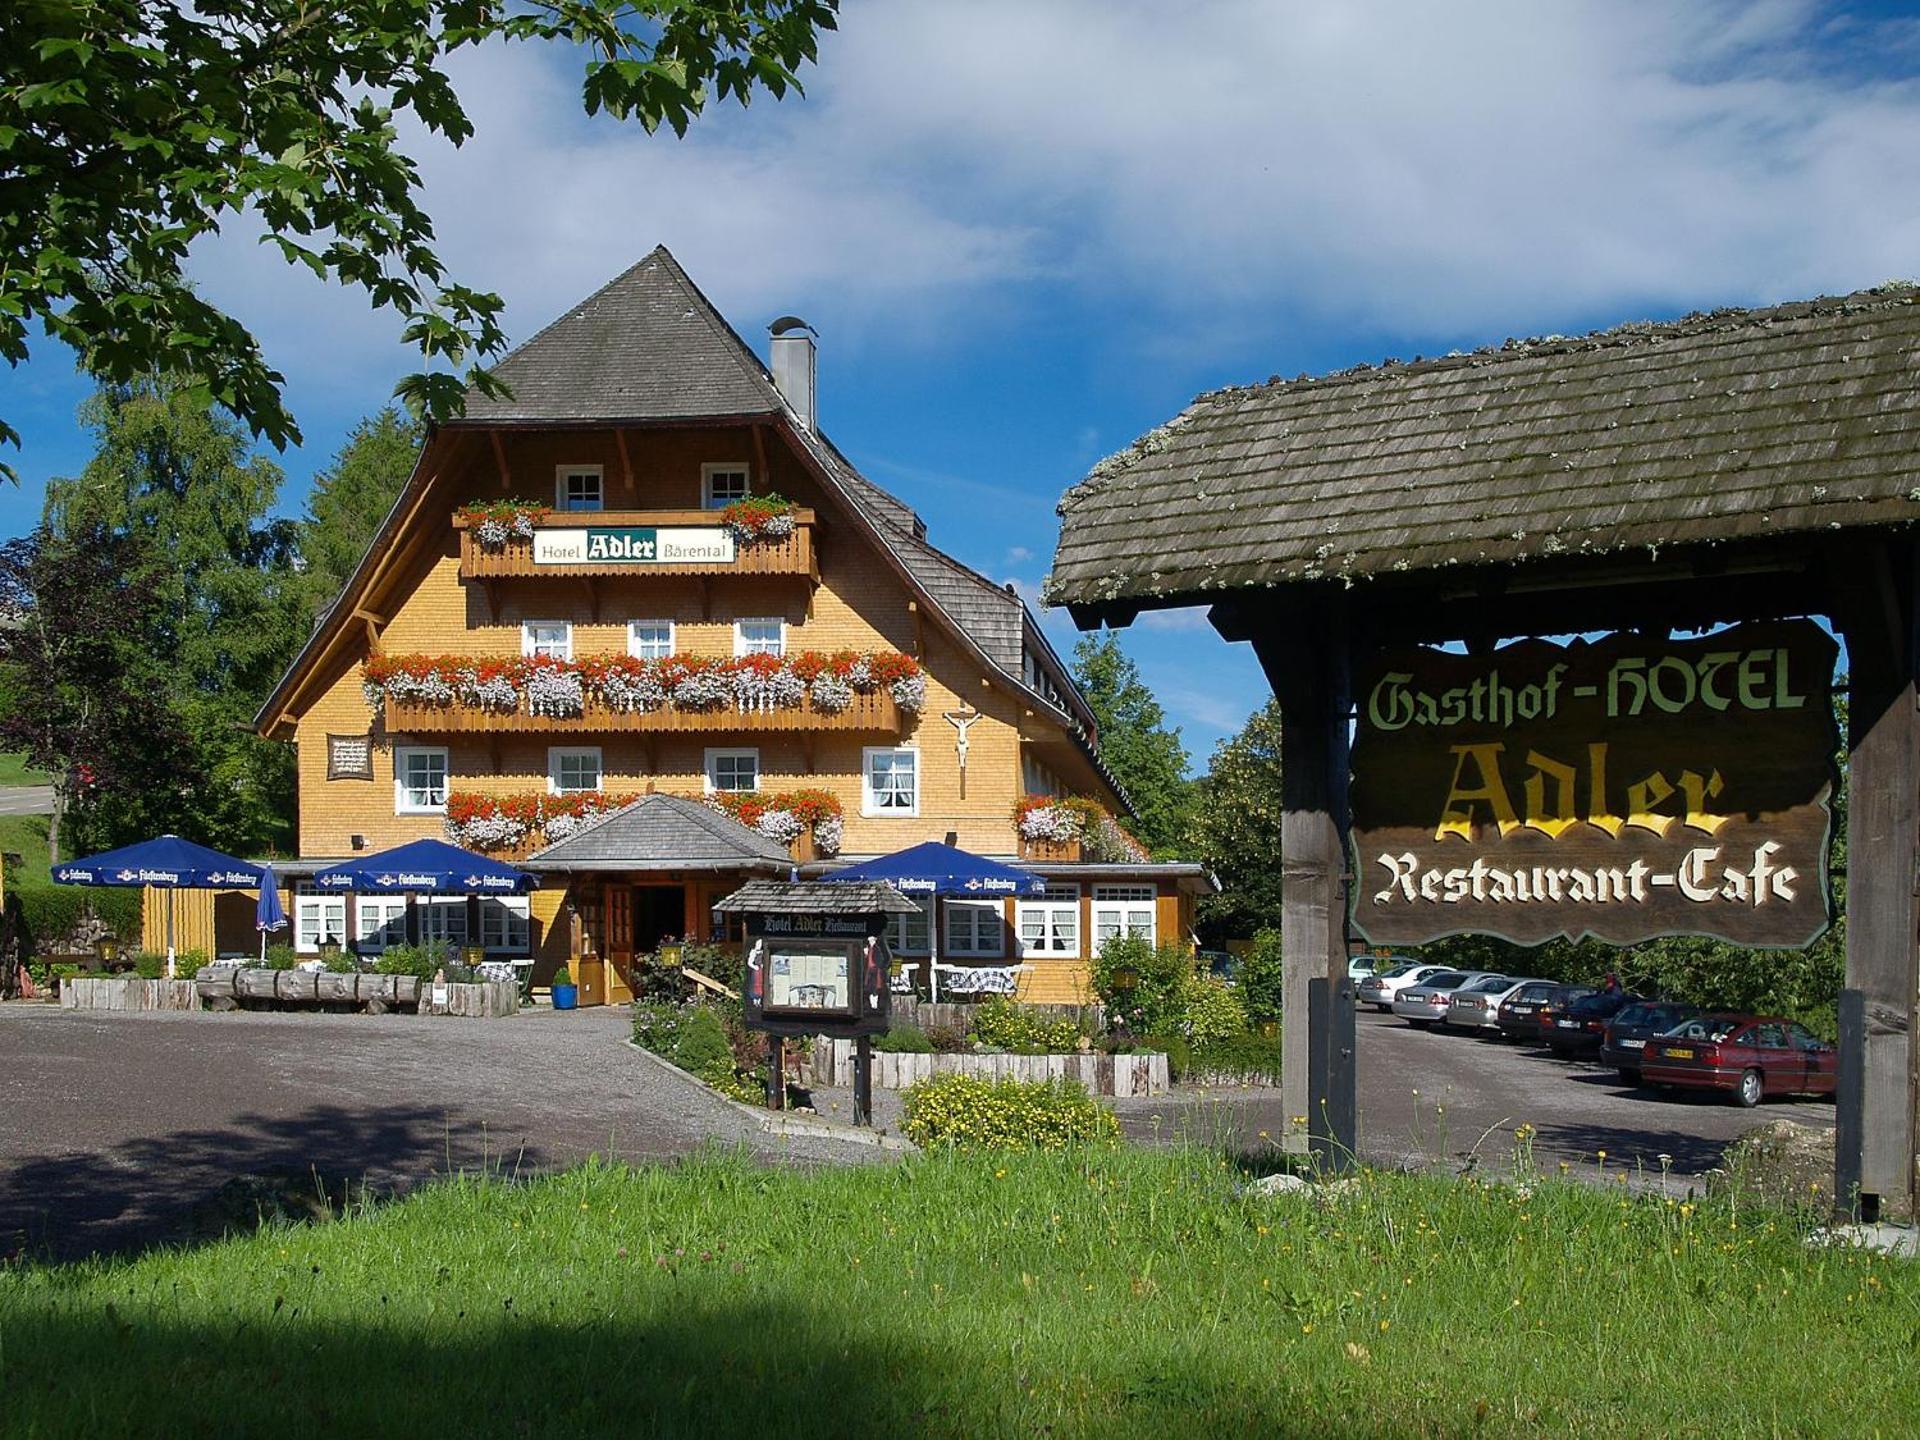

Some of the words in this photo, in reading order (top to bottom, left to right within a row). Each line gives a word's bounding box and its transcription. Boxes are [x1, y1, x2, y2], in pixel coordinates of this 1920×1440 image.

[541, 545, 580, 559] Hotel
[588, 534, 655, 559] Adler
[663, 543, 726, 558] Bärental
[1434, 741, 1730, 843] Adler
